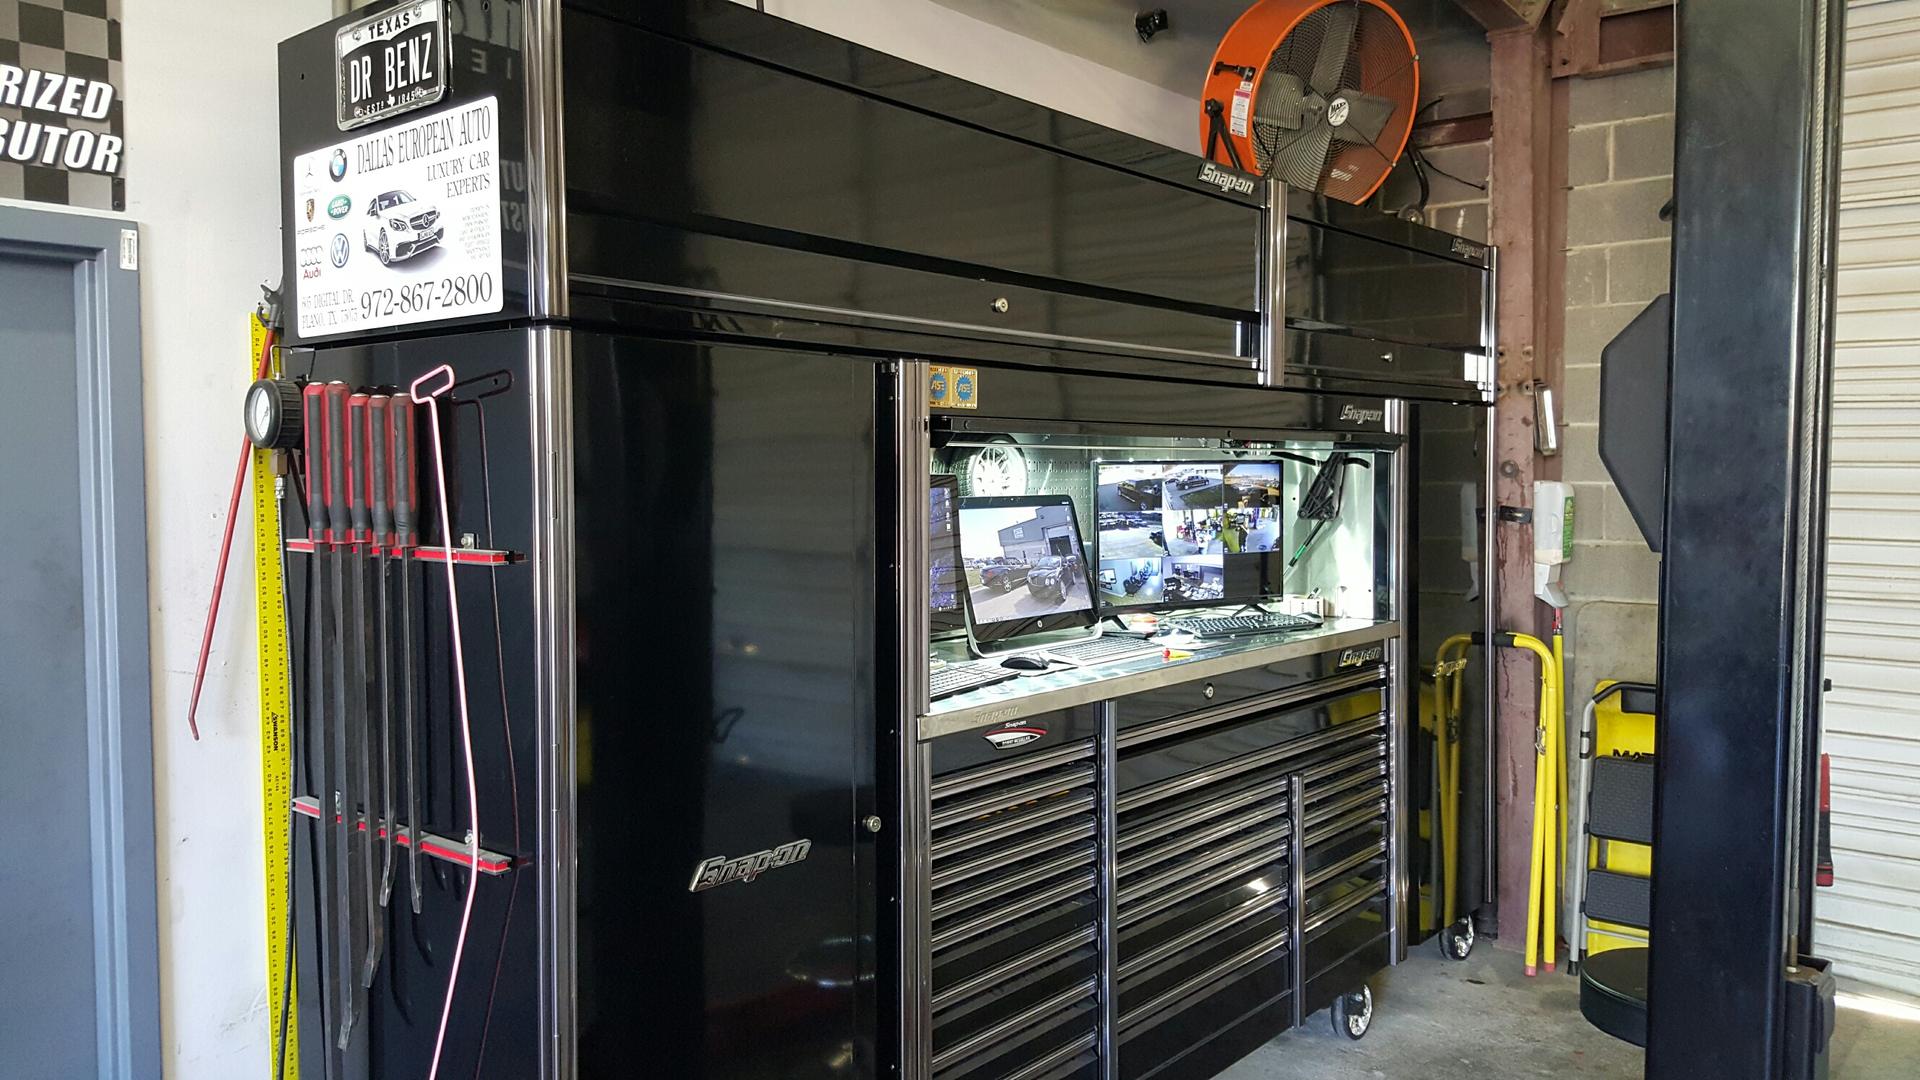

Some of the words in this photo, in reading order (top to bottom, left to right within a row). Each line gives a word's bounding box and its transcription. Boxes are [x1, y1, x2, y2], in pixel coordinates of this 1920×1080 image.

[368, 12, 410, 40] TEXAS
[350, 55, 372, 104] DR
[385, 32, 433, 93] BENZ
[357, 134, 394, 175] DALLAS
[398, 115, 455, 164] EUROPEAN
[459, 105, 491, 147] AUTO
[427, 156, 465, 182] LUXURY
[470, 150, 490, 171] CAR
[1198, 162, 1254, 196] Snap-on
[446, 172, 491, 198] EXPERTS
[331, 199, 345, 208] LAND
[332, 206, 349, 216] ROVER
[302, 266, 322, 280] Audi
[314, 290, 340, 308] DIGITAL
[360, 272, 492, 320] 972-867-2800
[930, 380, 945, 390] ASE
[1340, 404, 1382, 424] Snap-on
[1338, 646, 1382, 667] Snap-on
[688, 838, 812, 893] Snap-on
